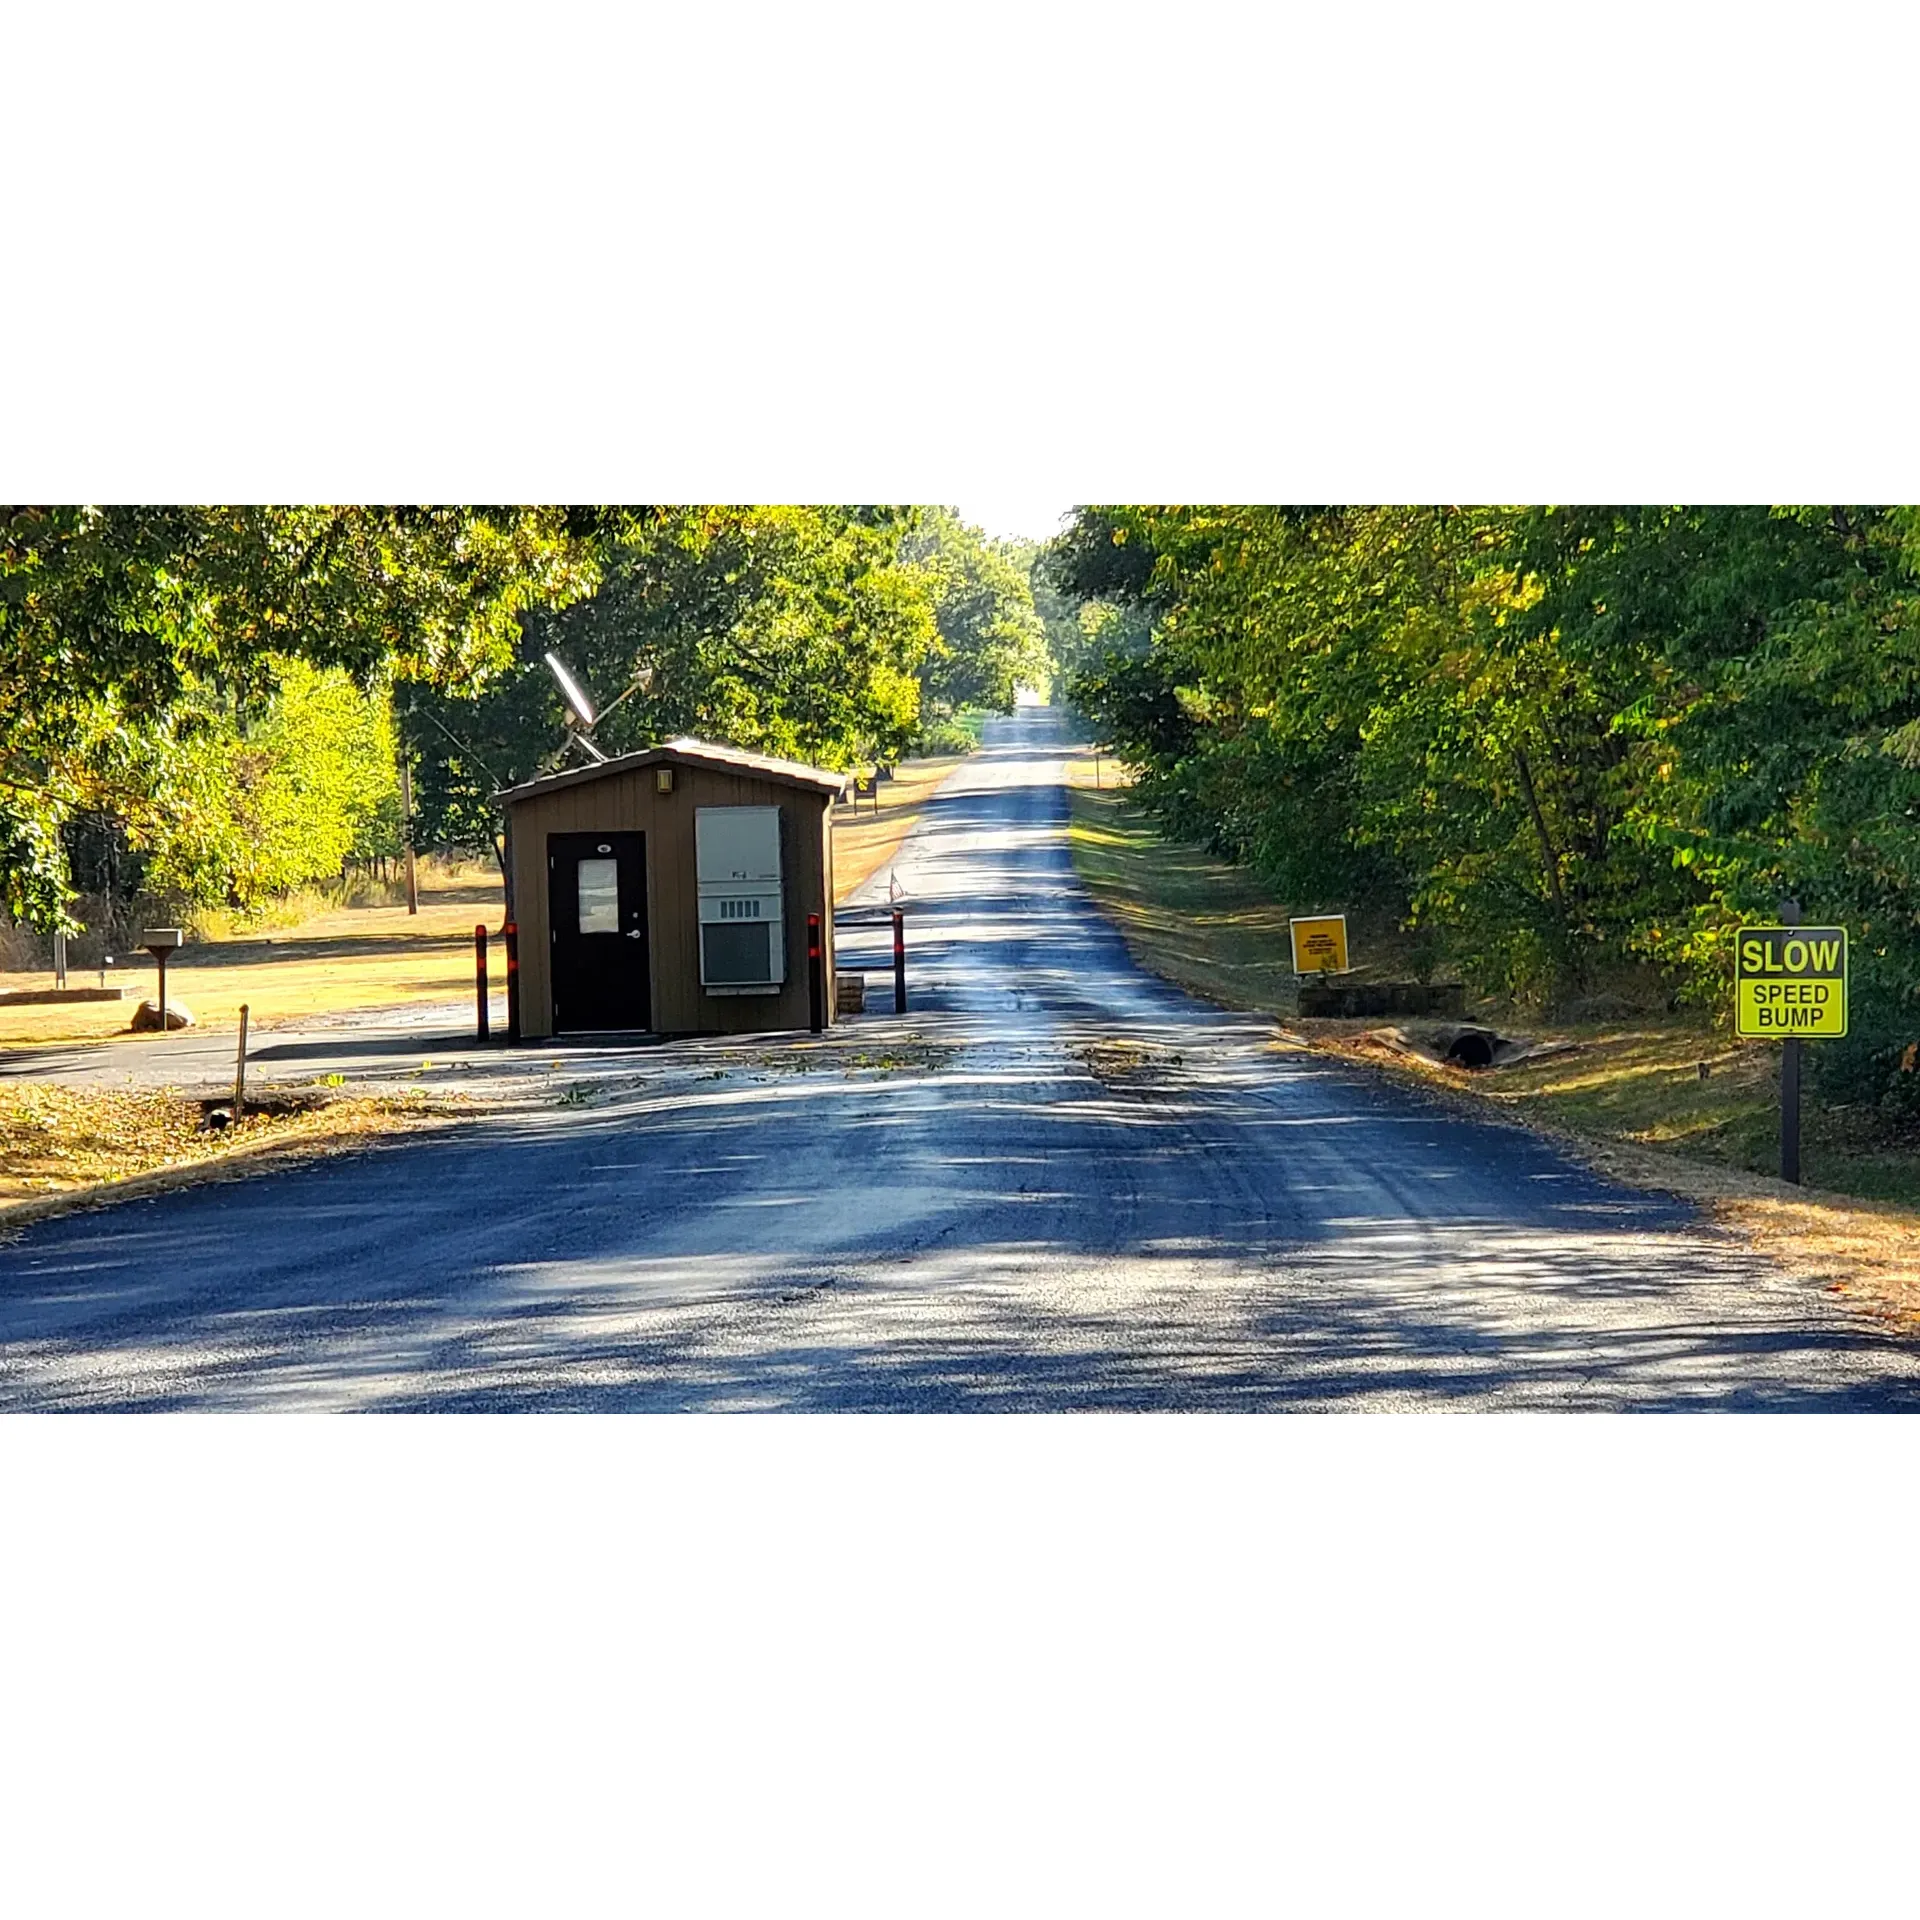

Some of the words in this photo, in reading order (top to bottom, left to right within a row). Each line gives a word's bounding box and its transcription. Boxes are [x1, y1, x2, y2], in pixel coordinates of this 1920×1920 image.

[1742, 940, 1840, 973] SLOW
[1753, 984, 1829, 1004] SPEED
[1758, 1008, 1824, 1027] BUMP
